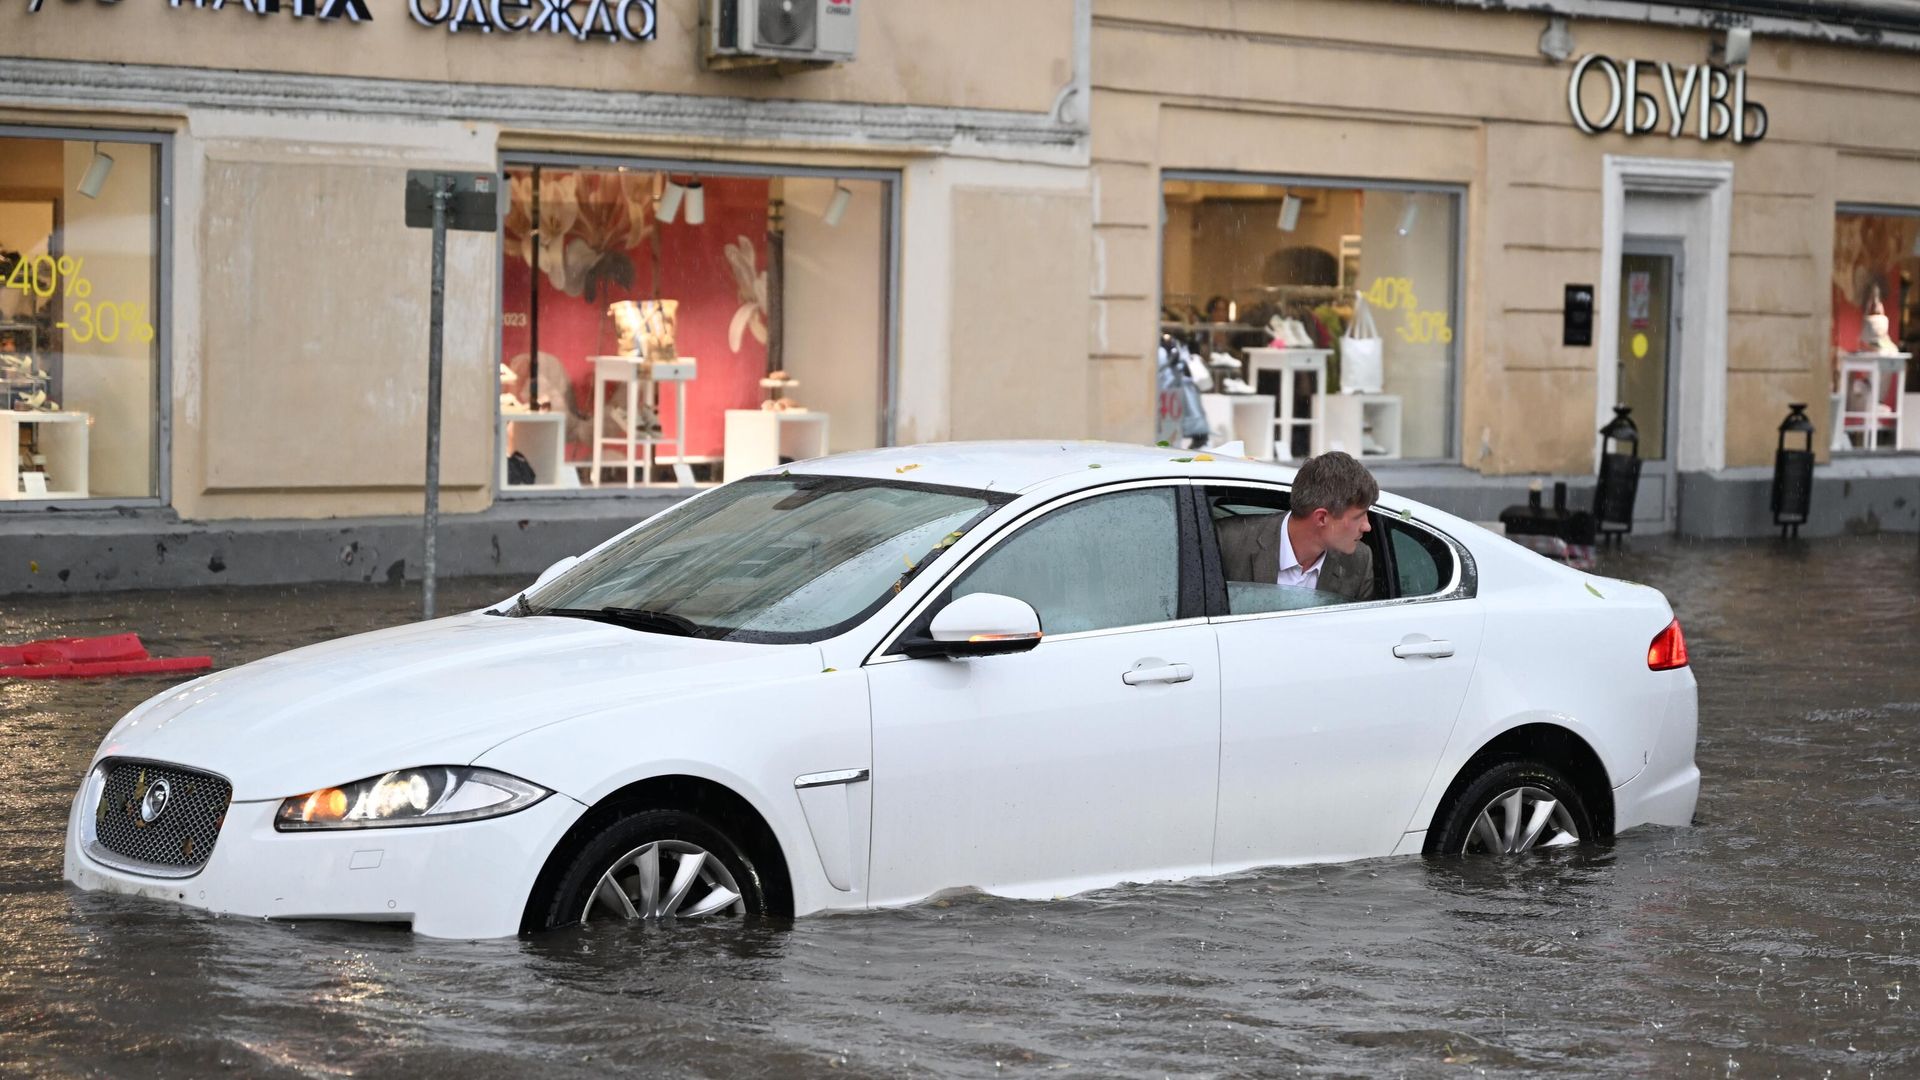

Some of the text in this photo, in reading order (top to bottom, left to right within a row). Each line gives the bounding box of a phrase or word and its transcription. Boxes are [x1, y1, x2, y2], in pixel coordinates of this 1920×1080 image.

[1569, 53, 1768, 143] ОБУВЬ
[56, 301, 154, 343] -30%
[502, 312, 527, 327] 023
[1395, 309, 1453, 344] -30%
